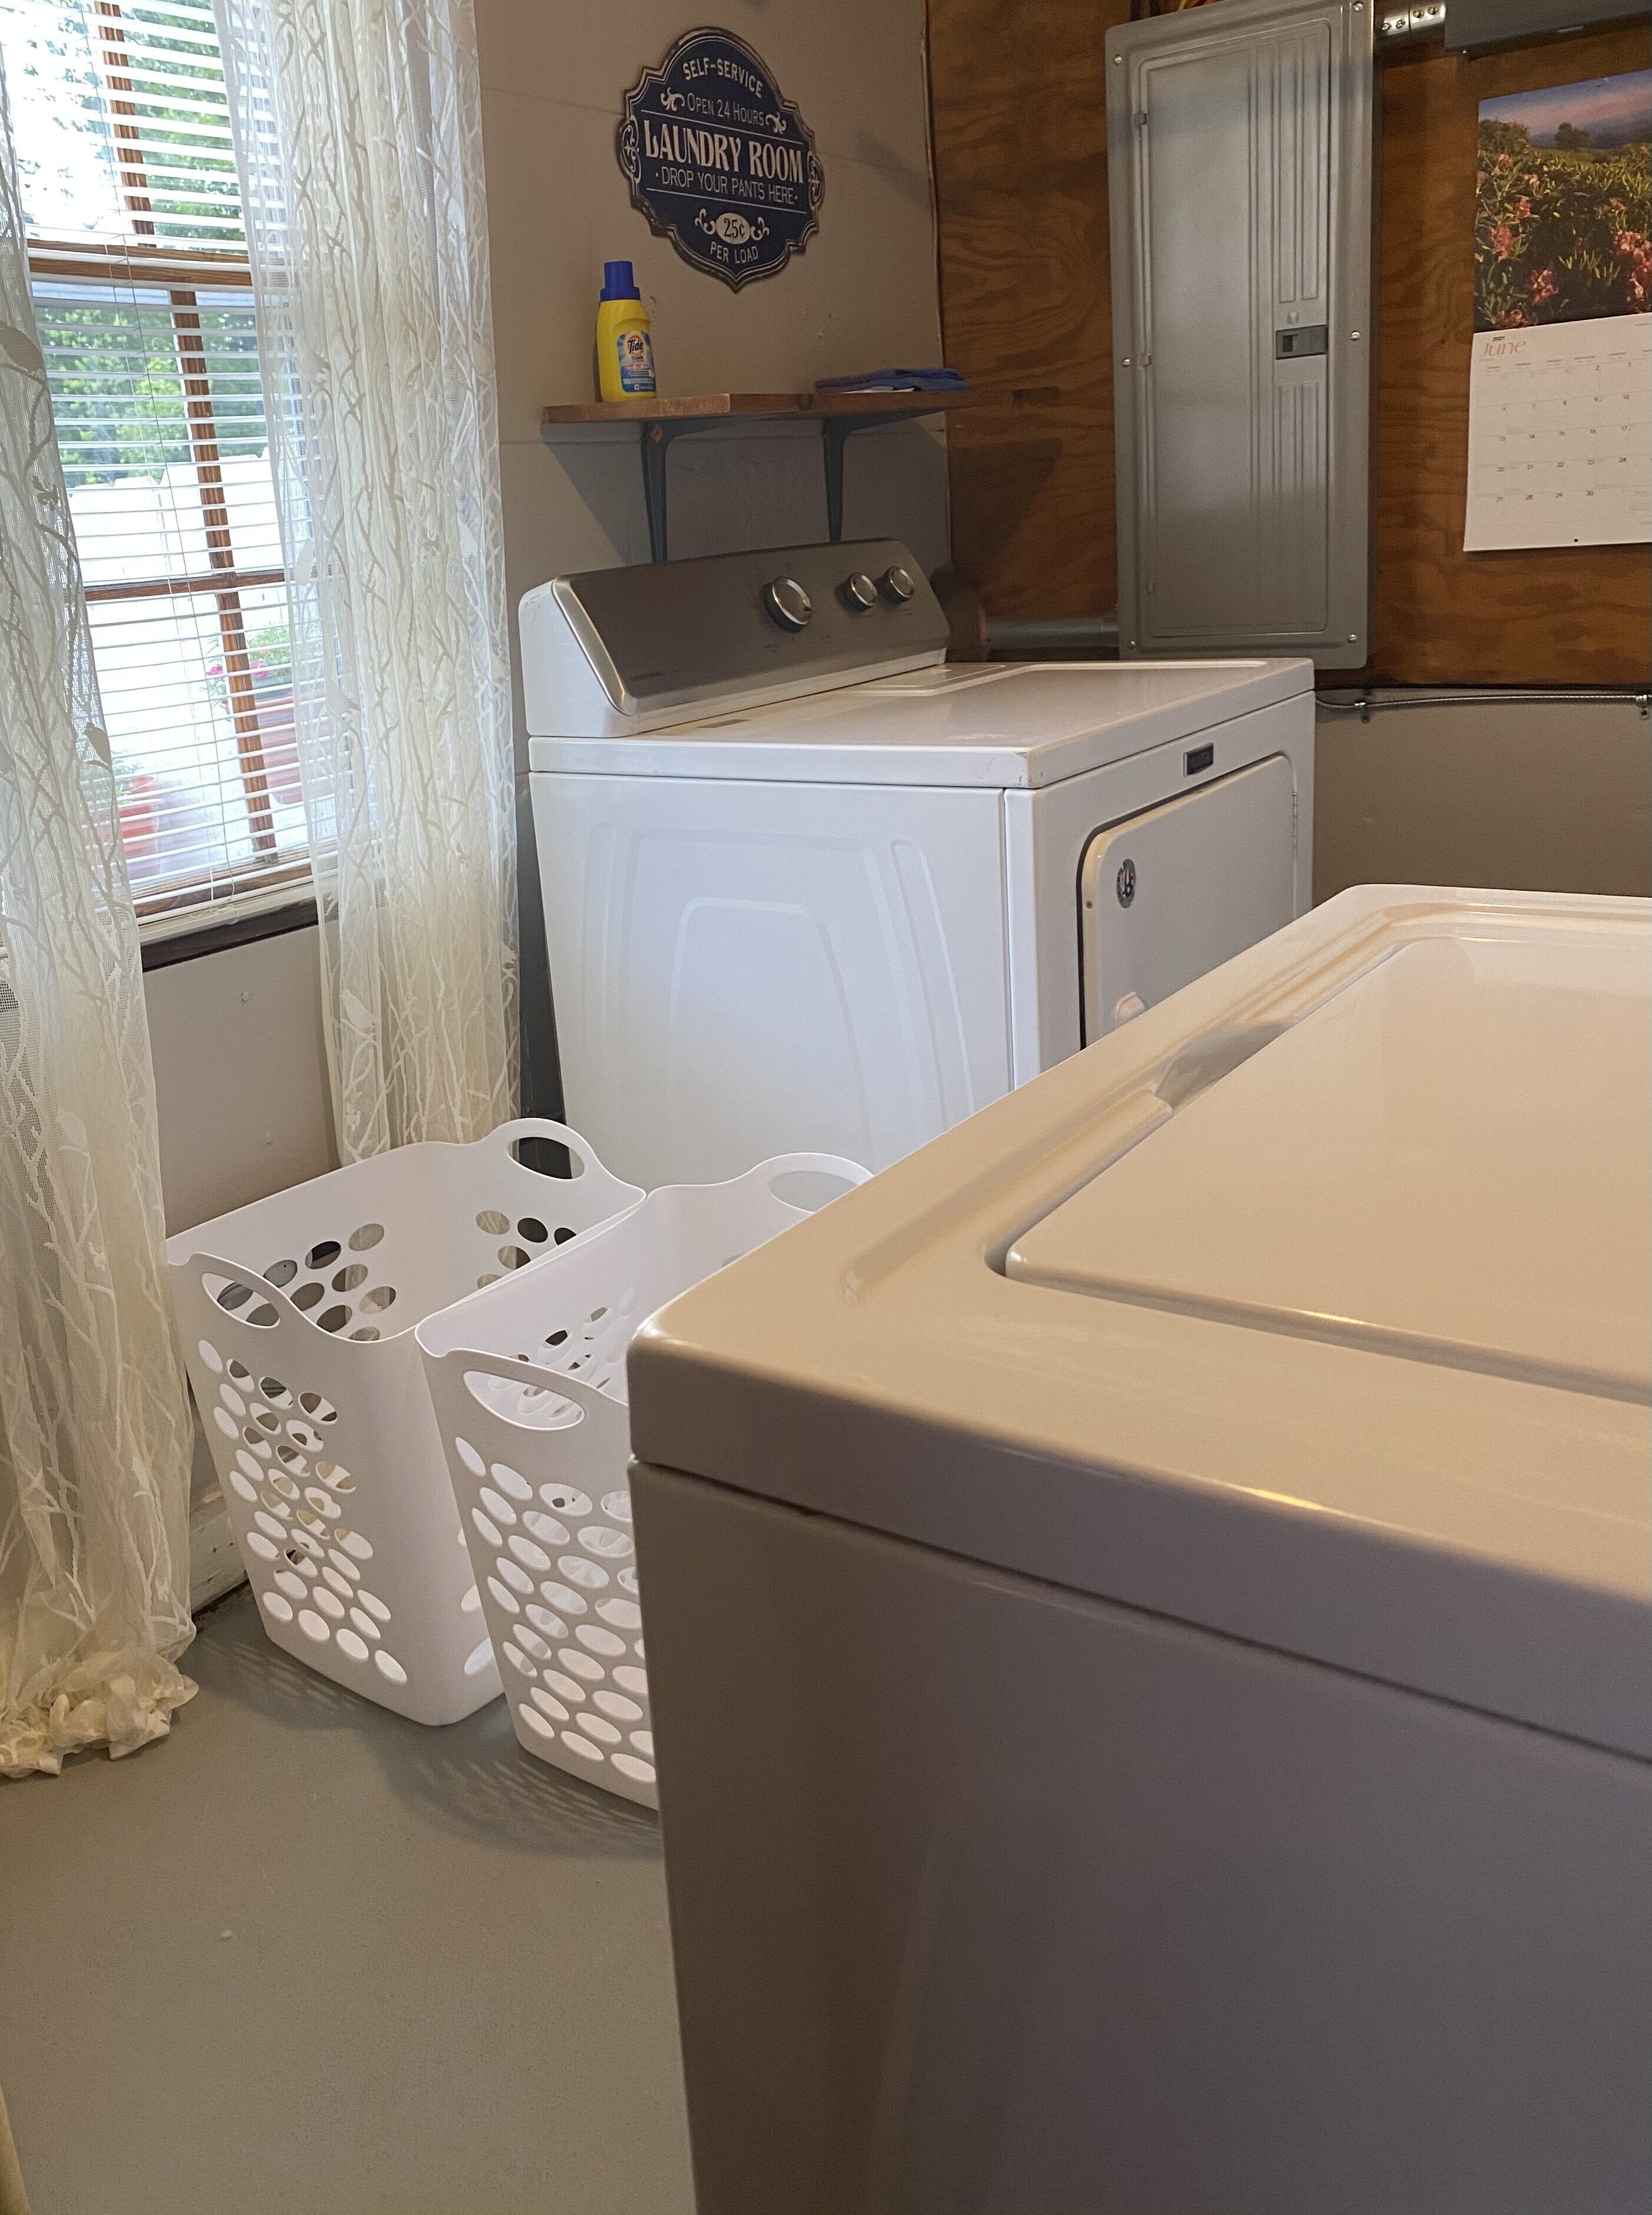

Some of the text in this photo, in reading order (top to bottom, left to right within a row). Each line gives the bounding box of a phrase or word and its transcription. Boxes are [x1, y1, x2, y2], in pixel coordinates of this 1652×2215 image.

[682, 58, 763, 98] SELF-SERVICE
[688, 93, 764, 126] OPEN 24 HOURS
[644, 120, 803, 184] LAUNDRY ROOM
[661, 166, 794, 204] DROP YOUR PANTS HERE
[724, 217, 744, 238] 25¢
[710, 241, 759, 263] PER LOAD
[628, 339, 644, 354] Tide
[1479, 341, 1526, 358] June
